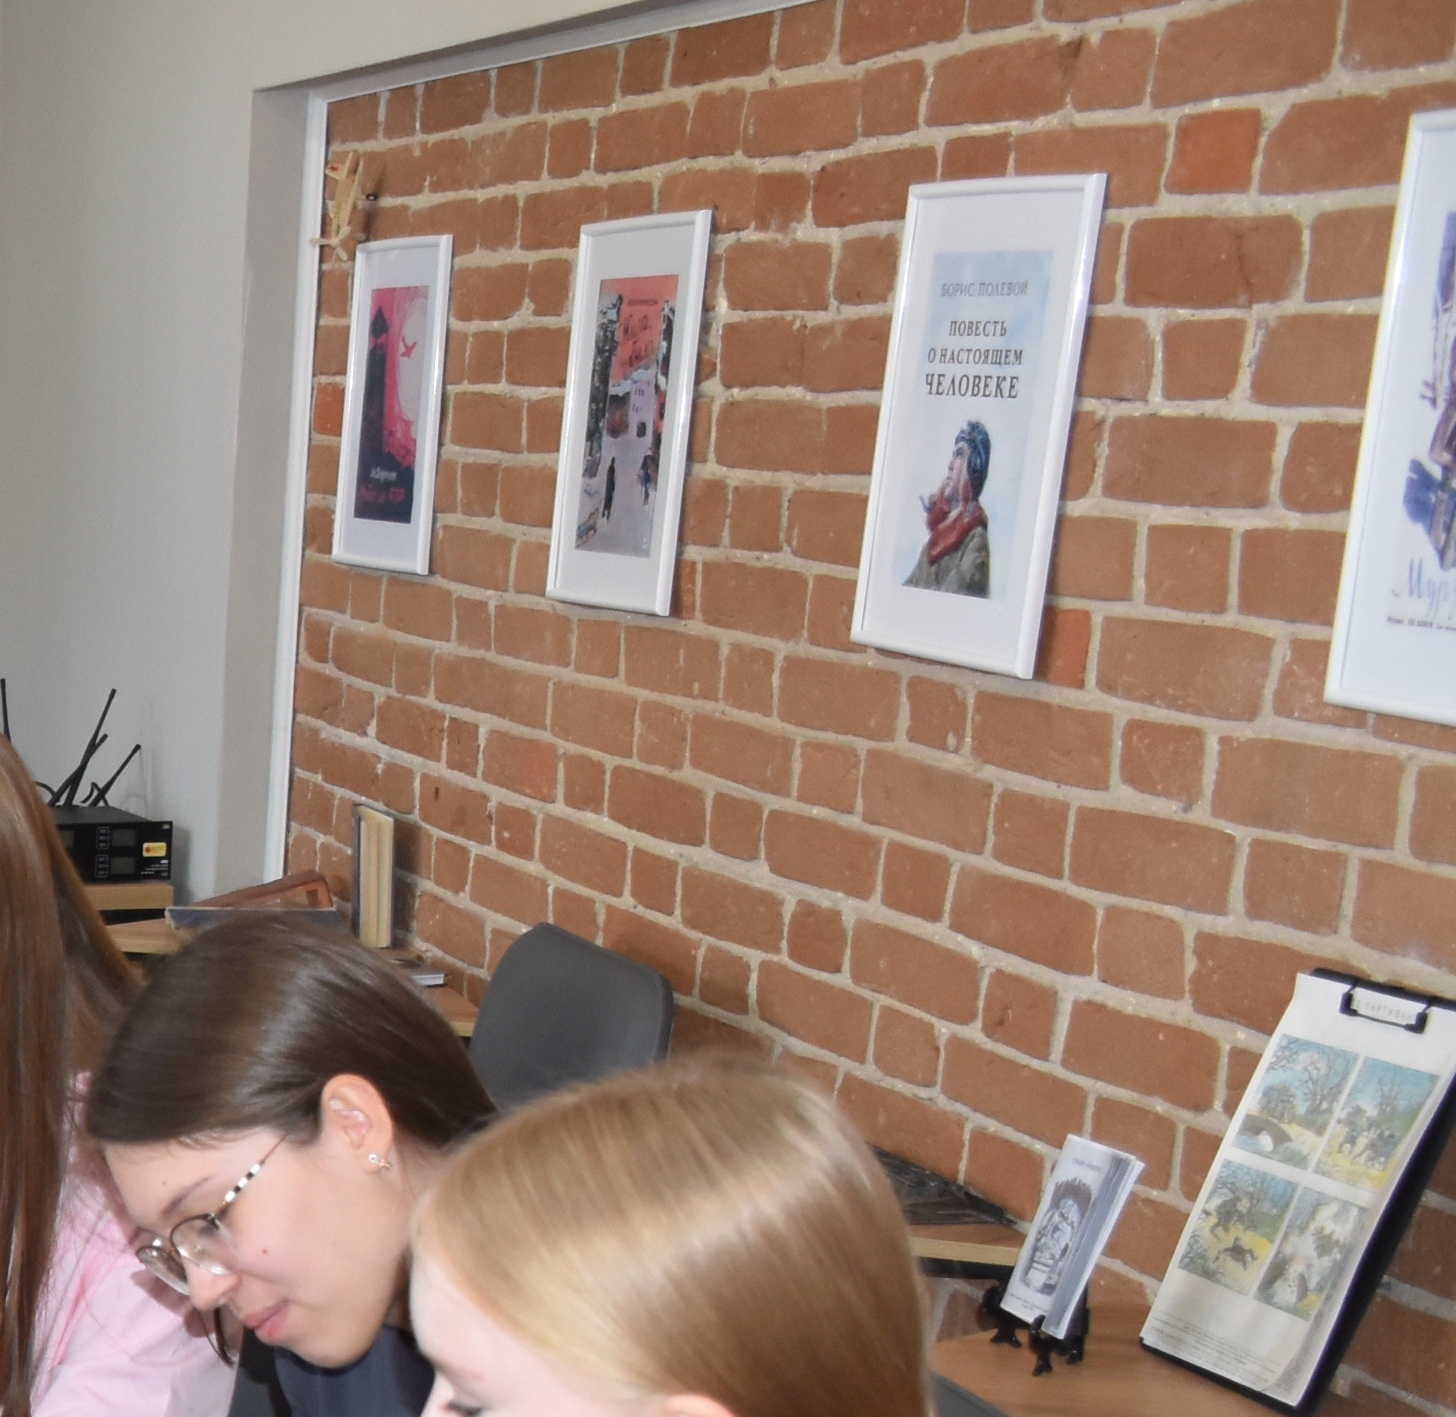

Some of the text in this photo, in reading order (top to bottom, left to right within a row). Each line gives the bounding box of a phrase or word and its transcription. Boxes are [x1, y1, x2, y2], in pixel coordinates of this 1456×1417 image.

[941, 279, 1029, 298] БОРИС ПОЛЕВОЙ
[948, 320, 1007, 338] ПОВЕСТЬ
[927, 347, 1024, 367] О НАСТОЯЩЕМ
[925, 373, 1020, 400] ЧЕЛОВЕКЕ
